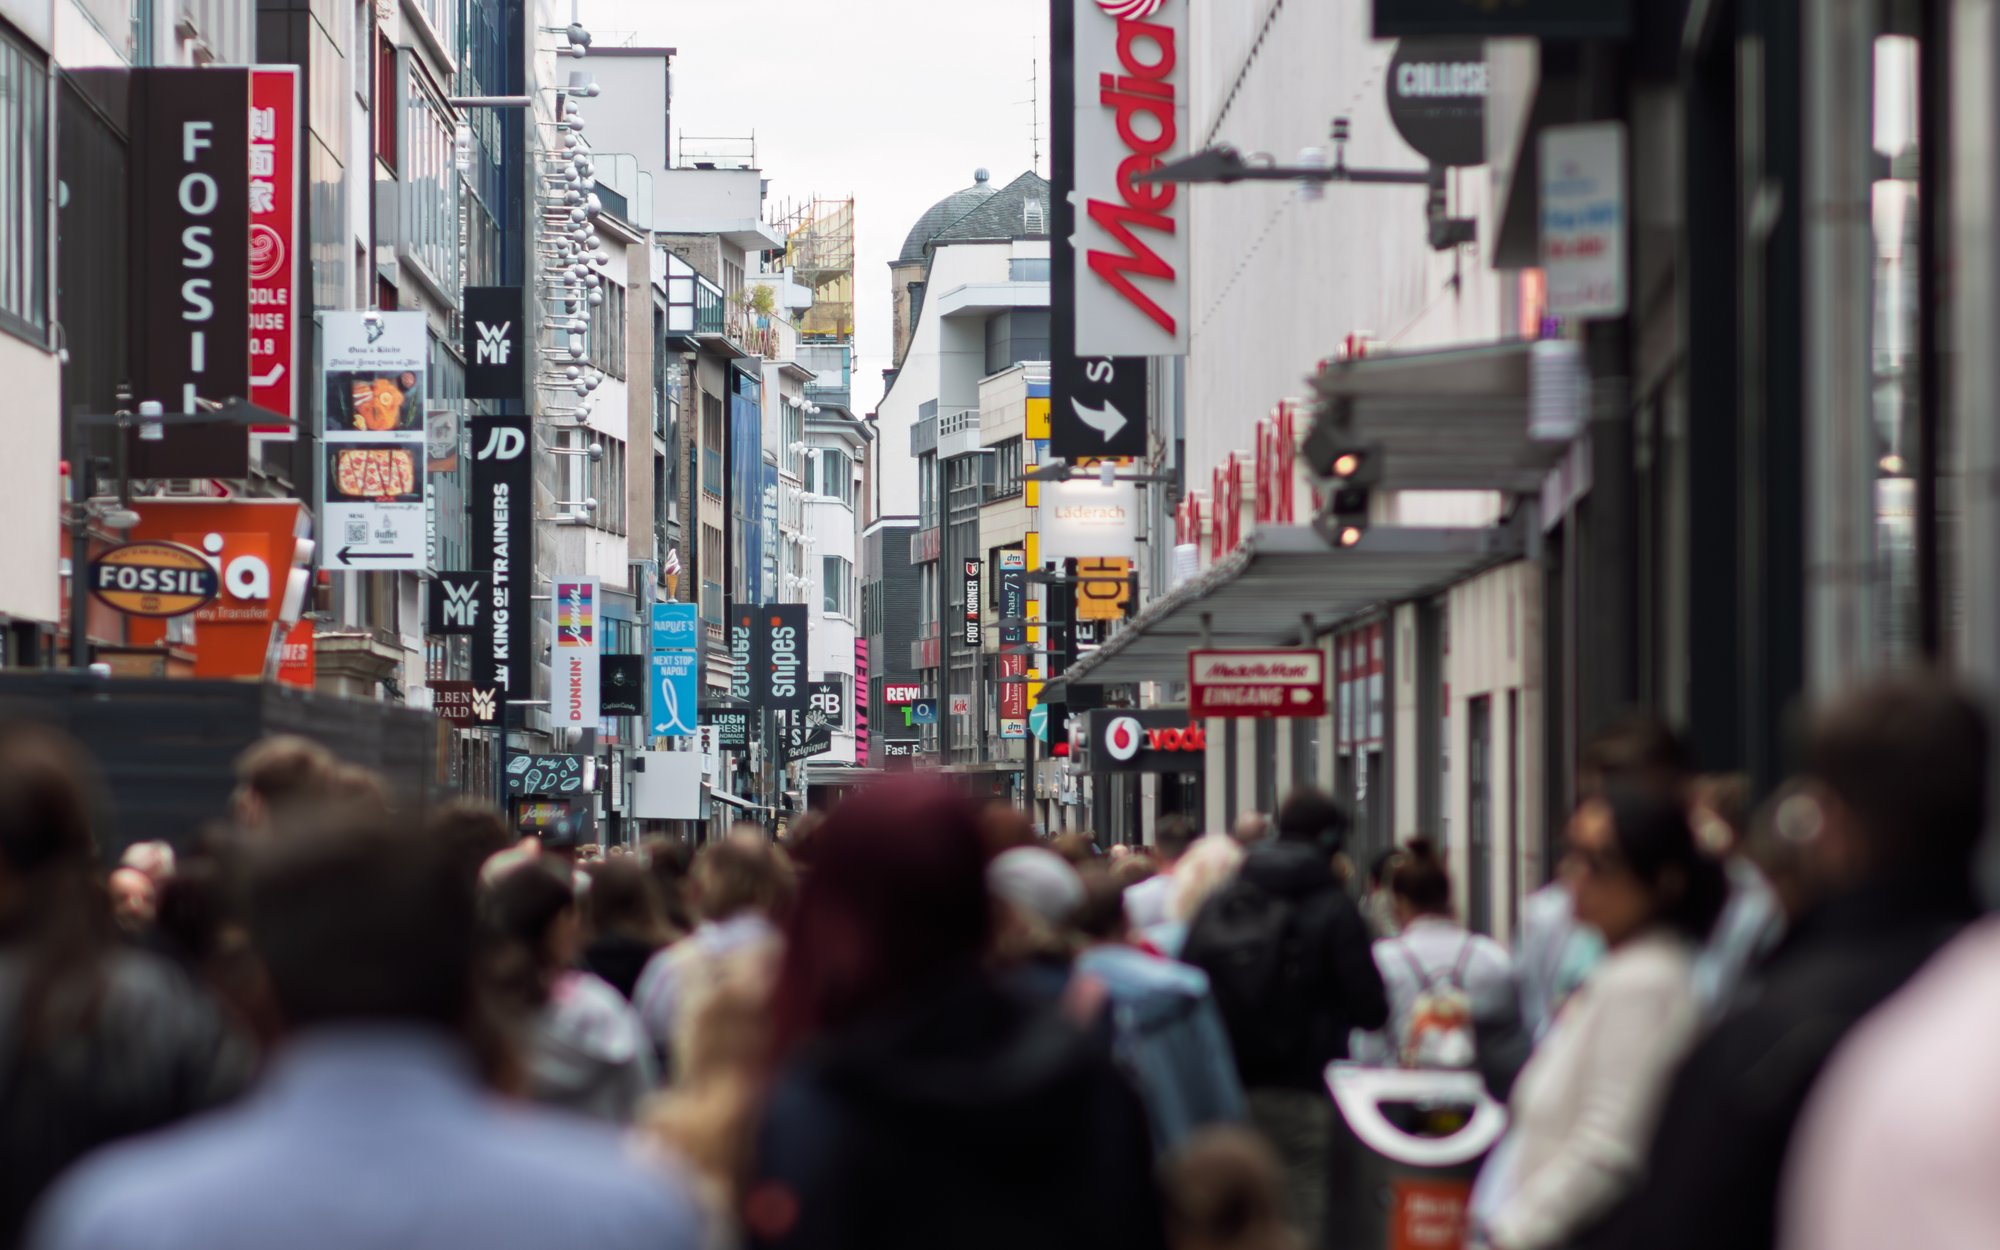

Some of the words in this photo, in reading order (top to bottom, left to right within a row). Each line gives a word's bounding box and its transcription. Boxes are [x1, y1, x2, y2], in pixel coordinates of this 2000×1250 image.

[1087, 17, 1177, 337] Media
[475, 320, 511, 365] WMF
[477, 426, 526, 461] JD
[493, 482, 509, 585] TRAINERS
[99, 566, 206, 595] FOSSIL
[493, 587, 508, 607] OF
[966, 580, 978, 614] KORNER
[441, 580, 480, 626] WMF
[493, 606, 509, 659] KING
[966, 621, 978, 643] FOOT
[771, 626, 801, 698] snipes
[711, 714, 745, 724] LUSH
[788, 740, 829, 758] Belgique
[884, 744, 910, 756] Fast.
